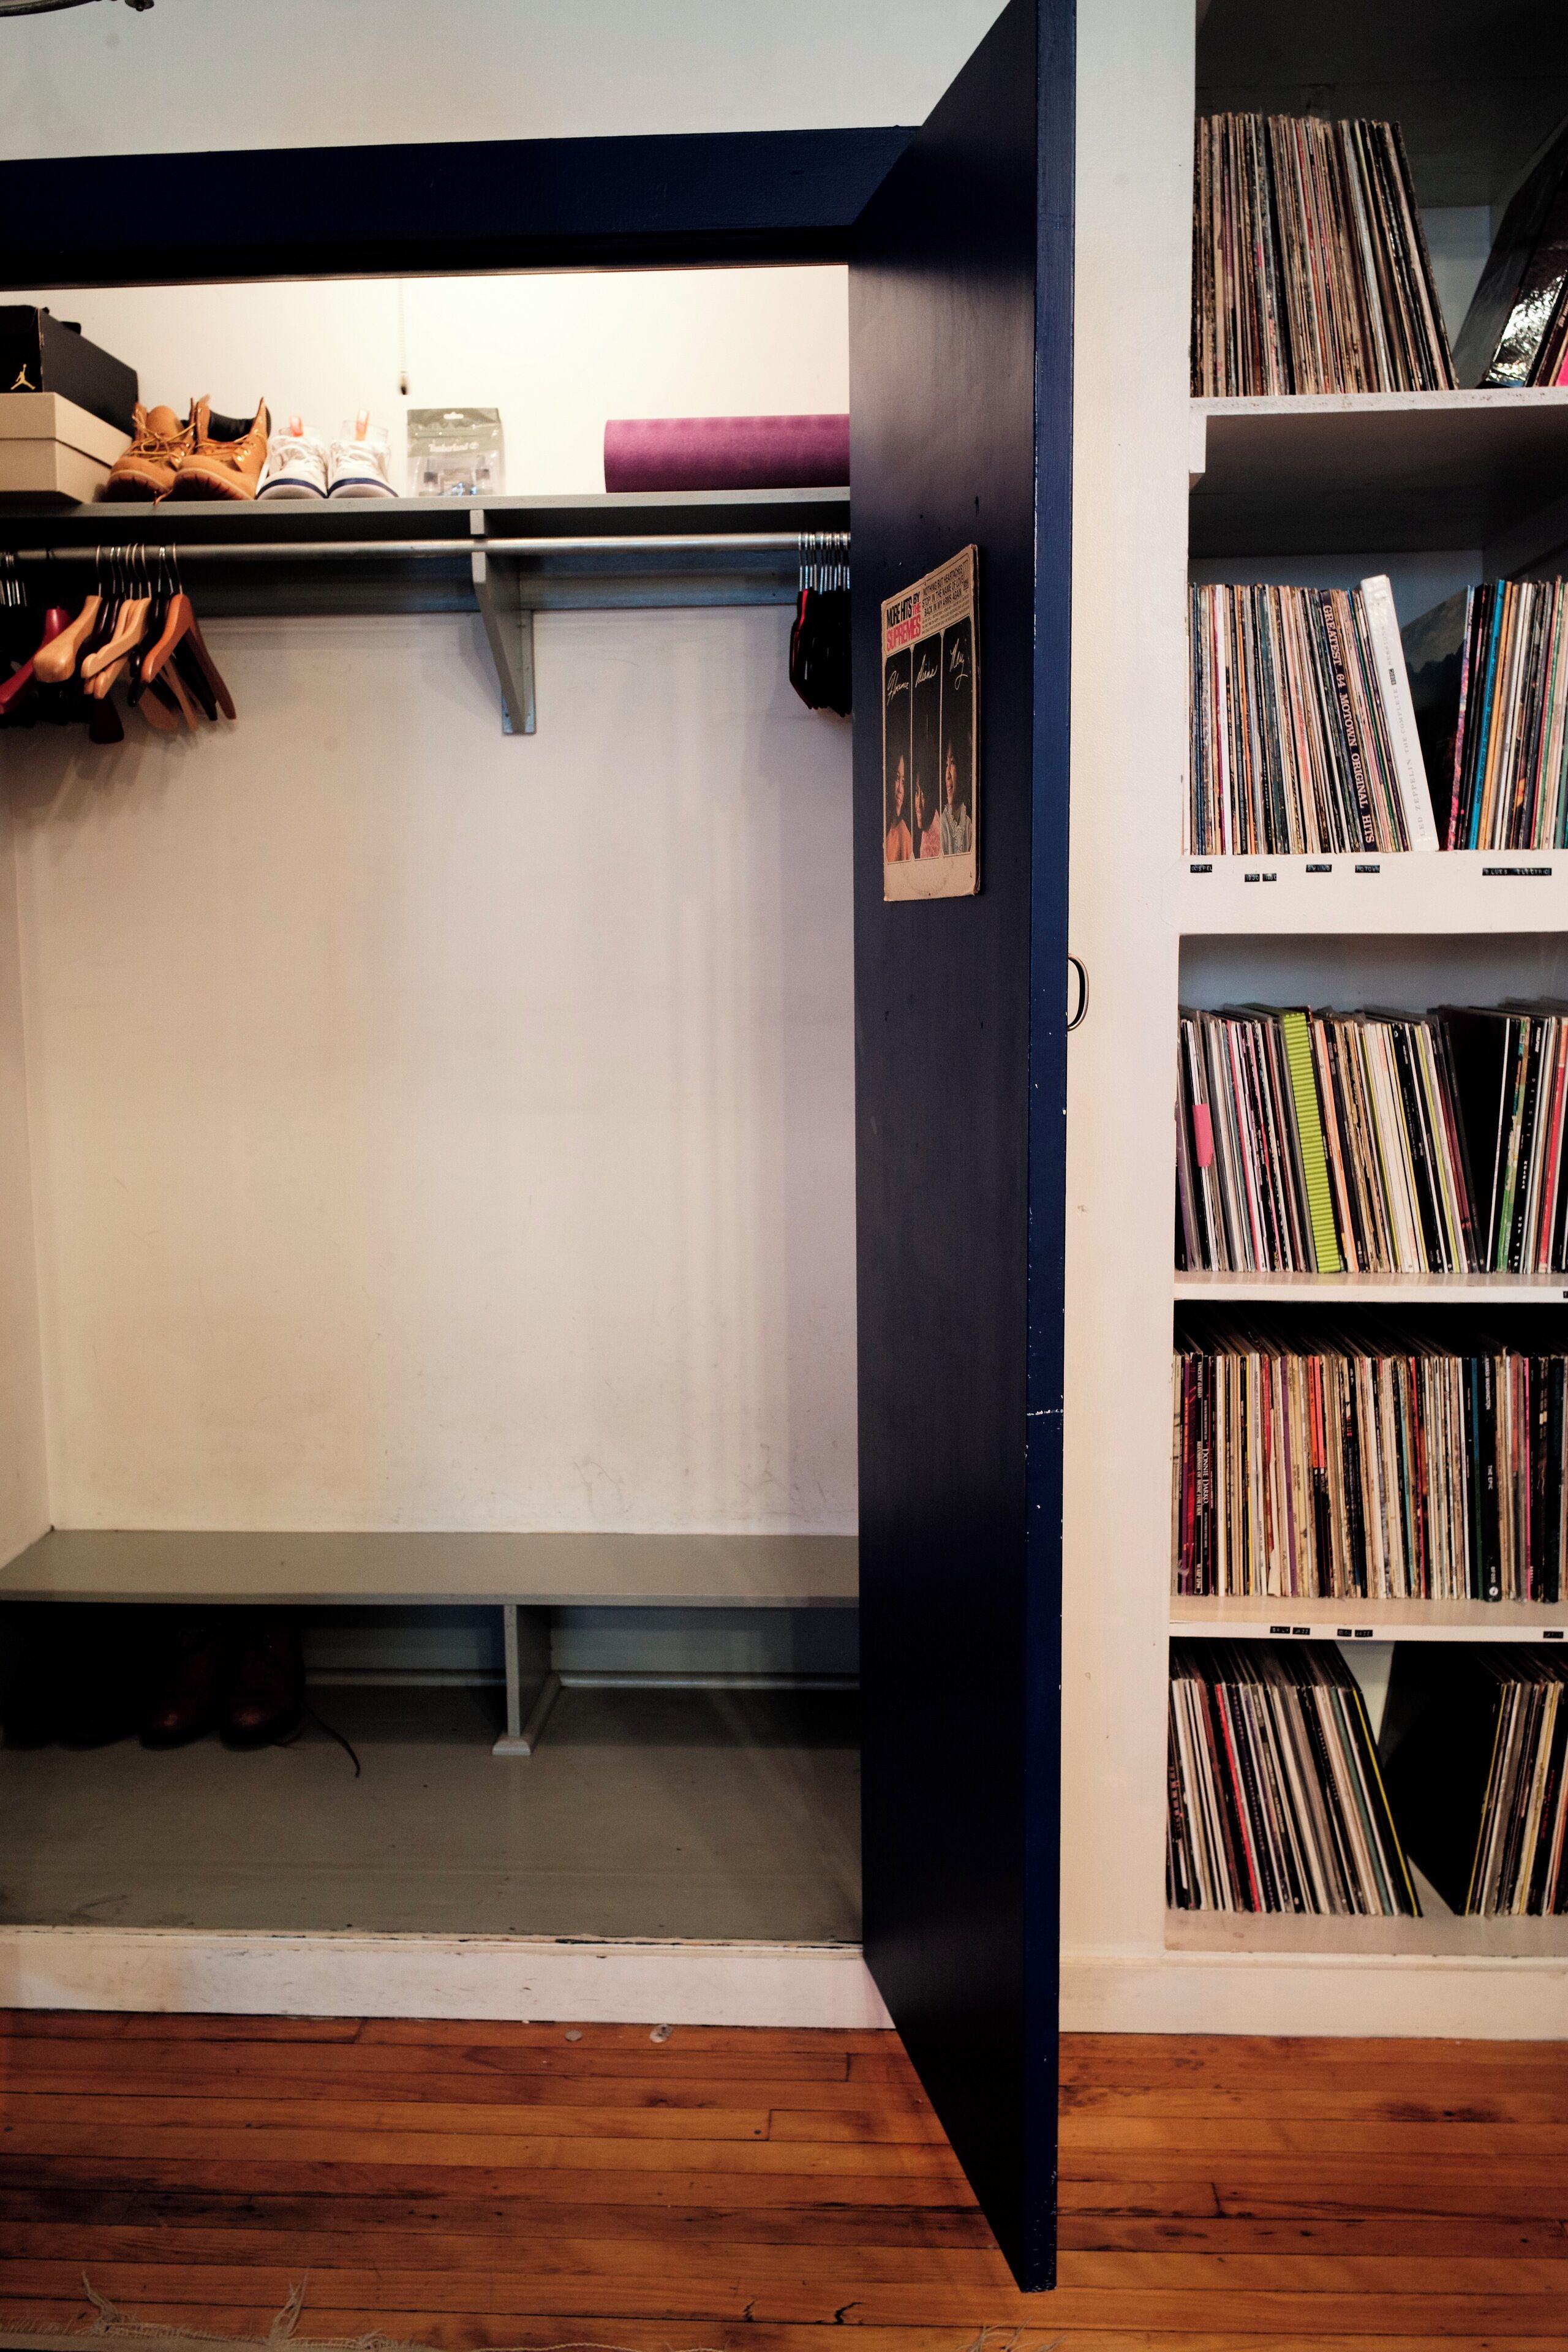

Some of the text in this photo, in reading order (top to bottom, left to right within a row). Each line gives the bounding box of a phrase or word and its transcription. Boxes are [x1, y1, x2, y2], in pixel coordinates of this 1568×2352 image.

[923, 581, 937, 596] NOTHING
[944, 564, 963, 583] HEARTACHES
[932, 594, 936, 603] IN
[942, 585, 951, 596] NAME
[951, 582, 957, 592] OF
[887, 603, 900, 630] MORE
[901, 596, 912, 622] HITS
[913, 591, 921, 604] BY
[913, 602, 921, 616] THE
[924, 606, 933, 617] BACK
[933, 603, 937, 612] IN
[937, 600, 943, 611] MY
[943, 594, 952, 608] ARMS
[952, 588, 962, 603] AGAIN
[887, 614, 921, 650] SUPREMES
[1381, 626, 1392, 666] SESSIONS
[1322, 604, 1374, 844] GREATEST 64 MOTOWN ORIGINAL HITS
[1393, 688, 1405, 734] COMPLETE
[1408, 759, 1420, 812] ZEPPELIN
